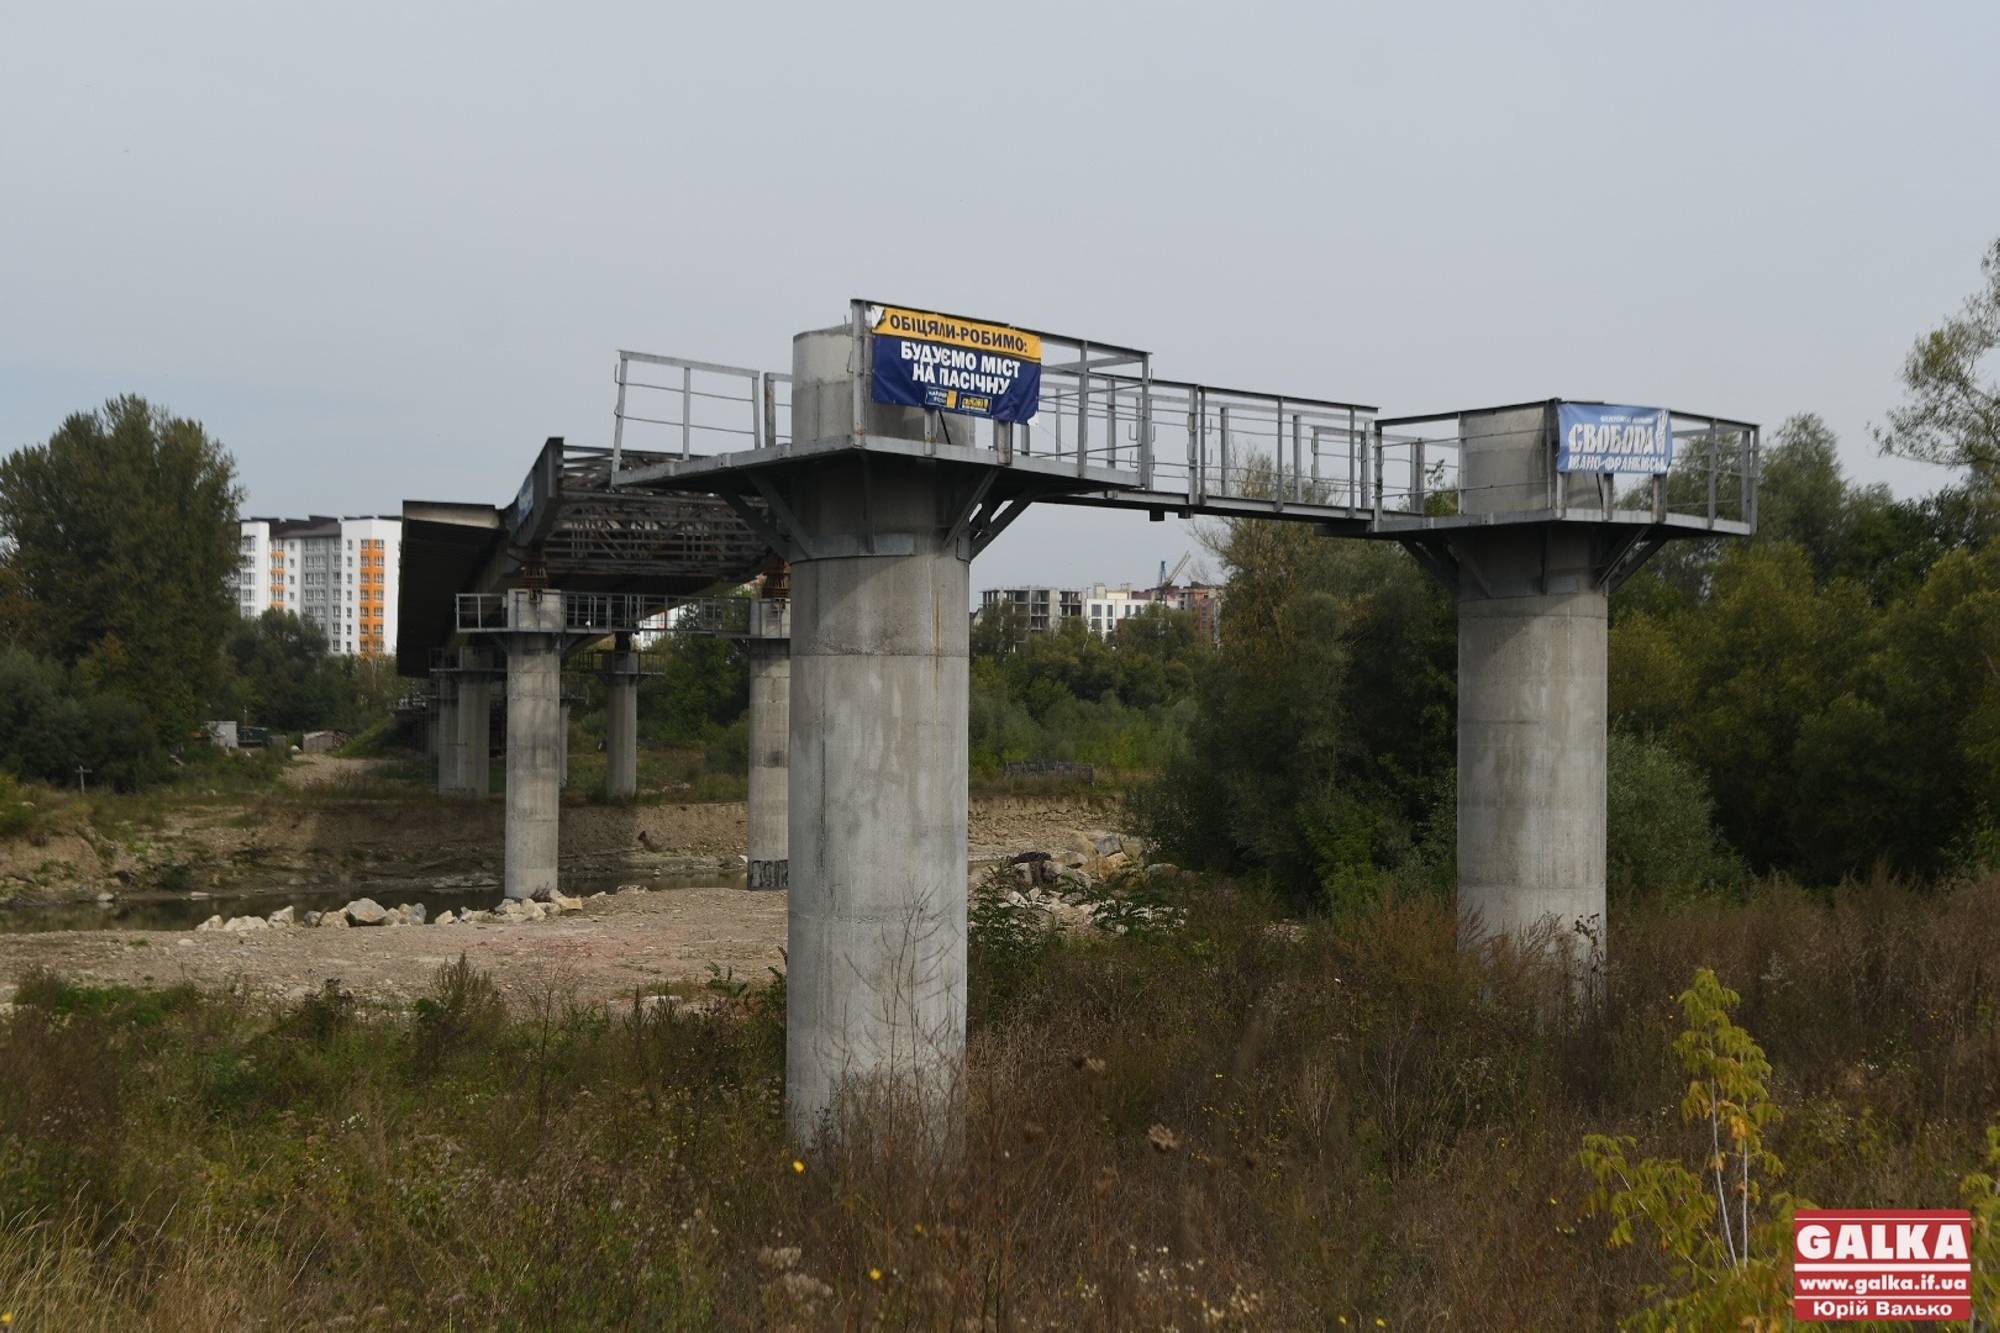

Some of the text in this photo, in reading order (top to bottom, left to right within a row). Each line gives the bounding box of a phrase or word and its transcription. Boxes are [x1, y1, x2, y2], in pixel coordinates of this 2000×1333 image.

[890, 314, 1028, 353] ОБІЦЯЛИ-РОБИМО:
[901, 341, 1020, 378] БУДУЄМО МІСТ
[912, 363, 1010, 395] НА ПАСІЧНУ
[1568, 424, 1654, 455] СВОБОДА
